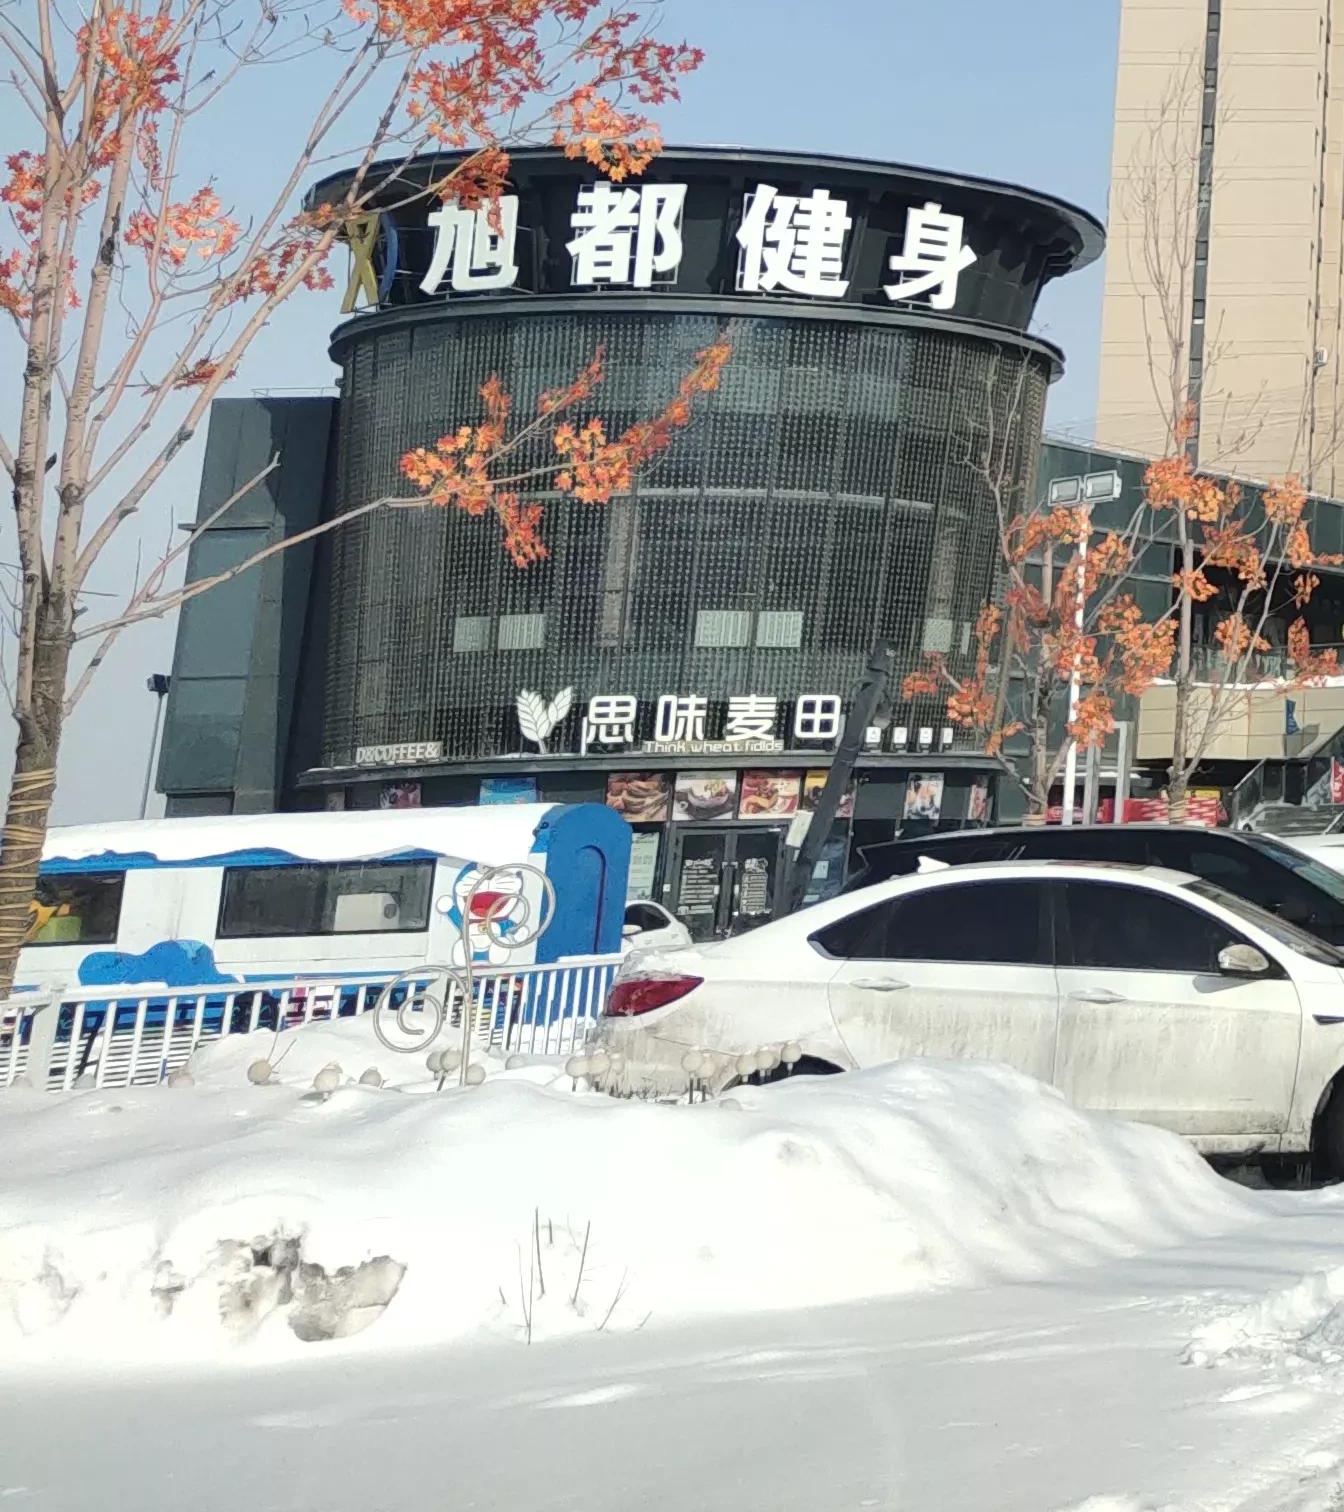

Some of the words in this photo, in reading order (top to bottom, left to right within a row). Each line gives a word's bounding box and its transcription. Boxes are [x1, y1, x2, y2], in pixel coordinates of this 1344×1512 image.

[420, 180, 978, 310] 旭都健身
[586, 694, 842, 743] 思味麦田
[645, 739, 686, 753] Think
[690, 739, 743, 753] wheat
